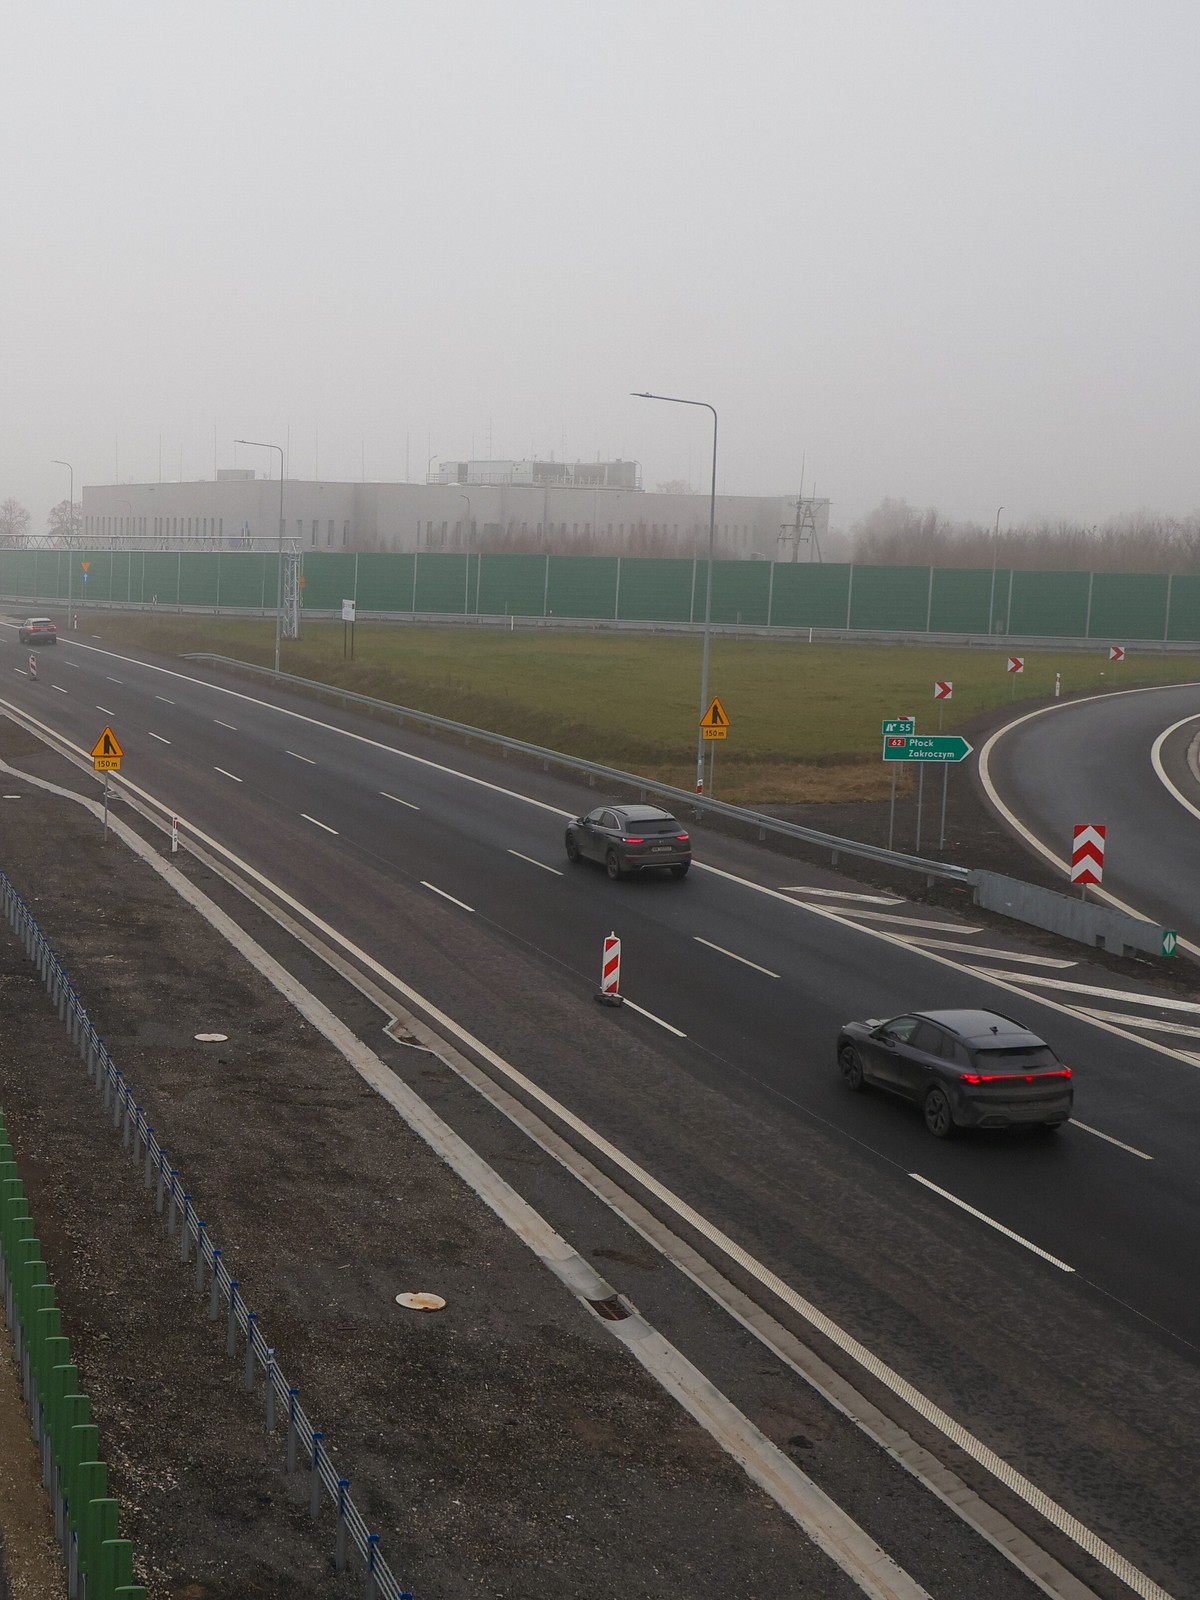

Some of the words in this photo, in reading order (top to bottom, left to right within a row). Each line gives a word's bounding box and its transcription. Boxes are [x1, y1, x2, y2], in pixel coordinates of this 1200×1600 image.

[900, 724, 911, 732] 55
[909, 739, 934, 747] Płock
[909, 750, 955, 759] Zakroczym
